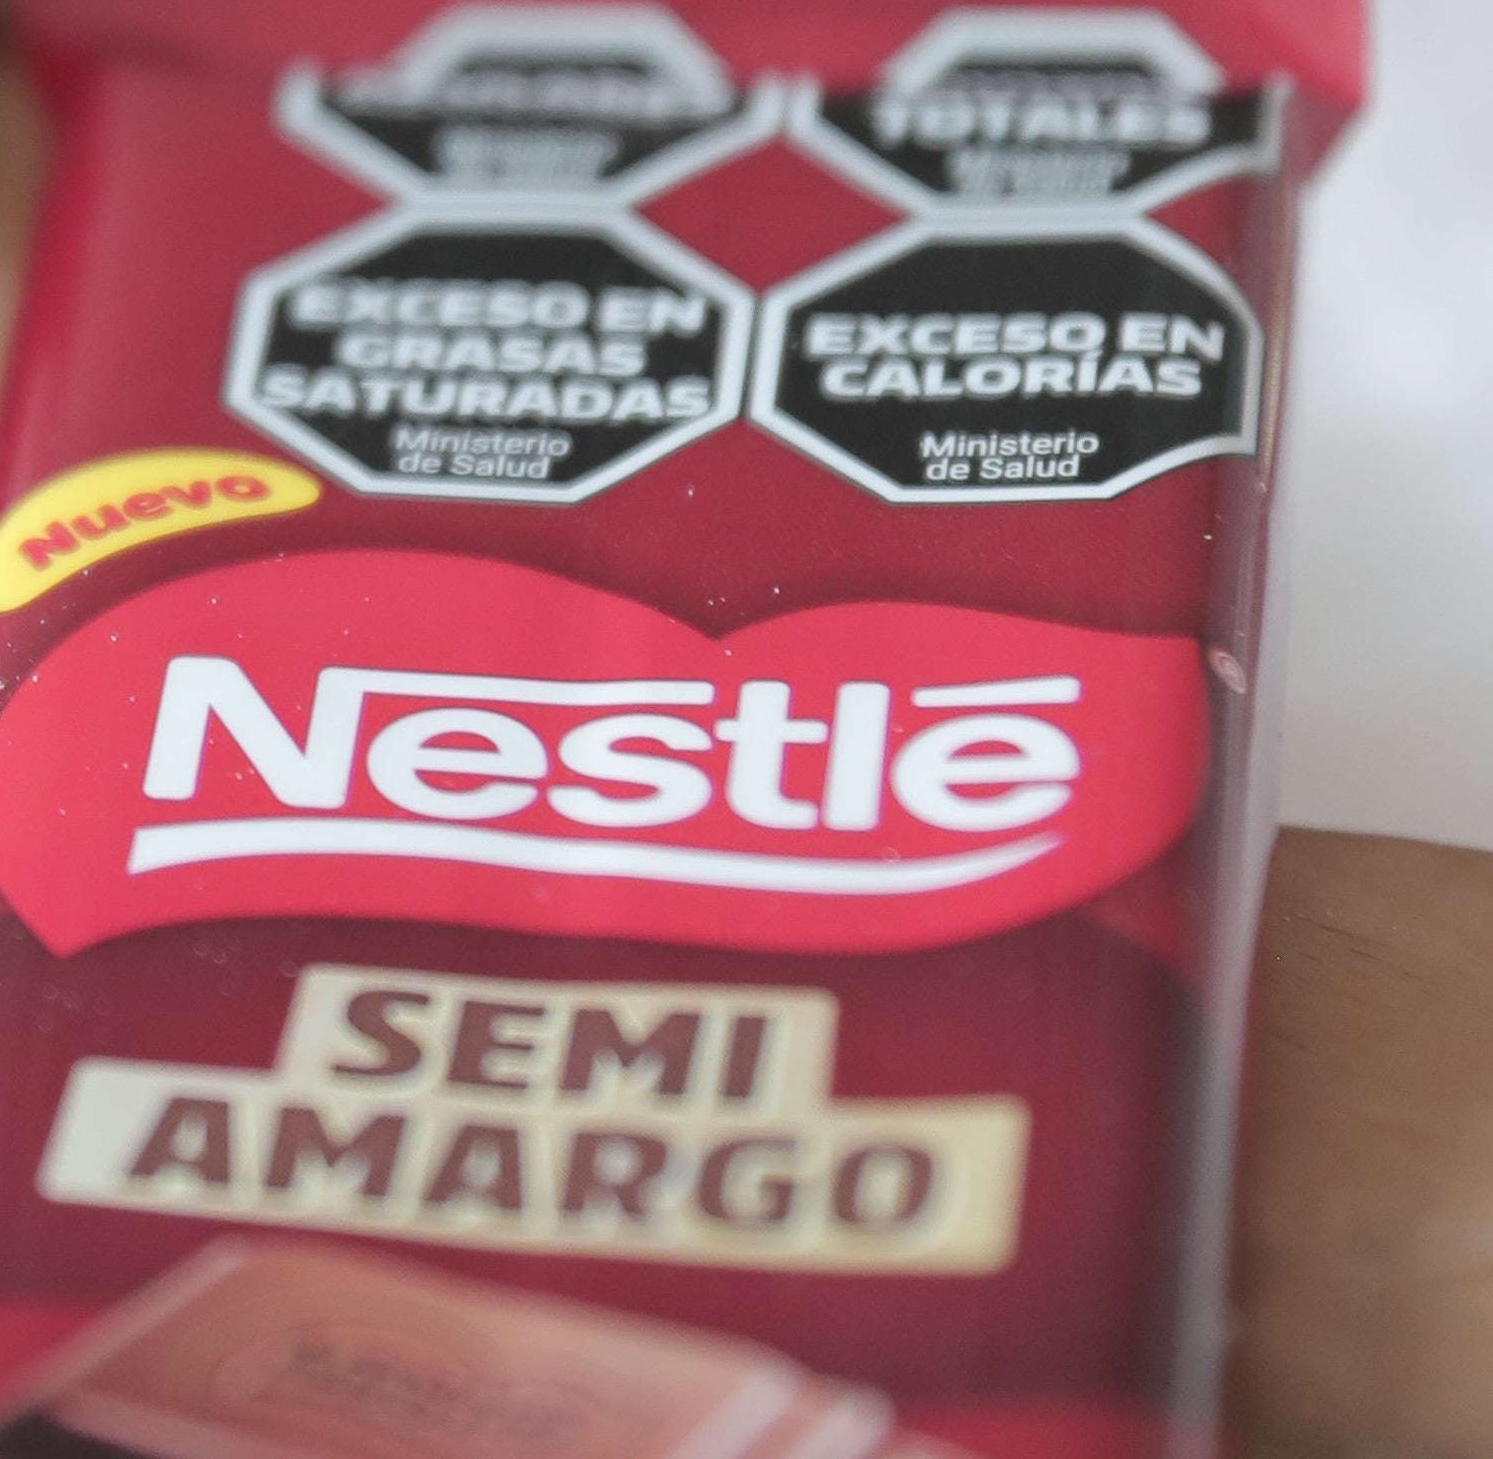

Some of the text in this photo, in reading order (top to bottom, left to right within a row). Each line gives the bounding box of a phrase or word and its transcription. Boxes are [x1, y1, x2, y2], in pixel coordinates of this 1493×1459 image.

[291, 280, 707, 337] EXCESO EN
[335, 330, 648, 377] GRASAS
[806, 312, 1225, 362] EXCESO EN
[259, 366, 711, 421] SATURADAS
[820, 350, 1202, 399] CALORÍAS
[389, 425, 574, 460] Ministerio
[397, 451, 551, 480] de Salud
[920, 429, 1100, 460] Ministerio
[926, 453, 1081, 481] de Salud
[19, 474, 271, 571] Nuevo
[142, 654, 1083, 832] Nestlé
[331, 988, 769, 1101] SEMI
[127, 1096, 937, 1228] AMARGO
